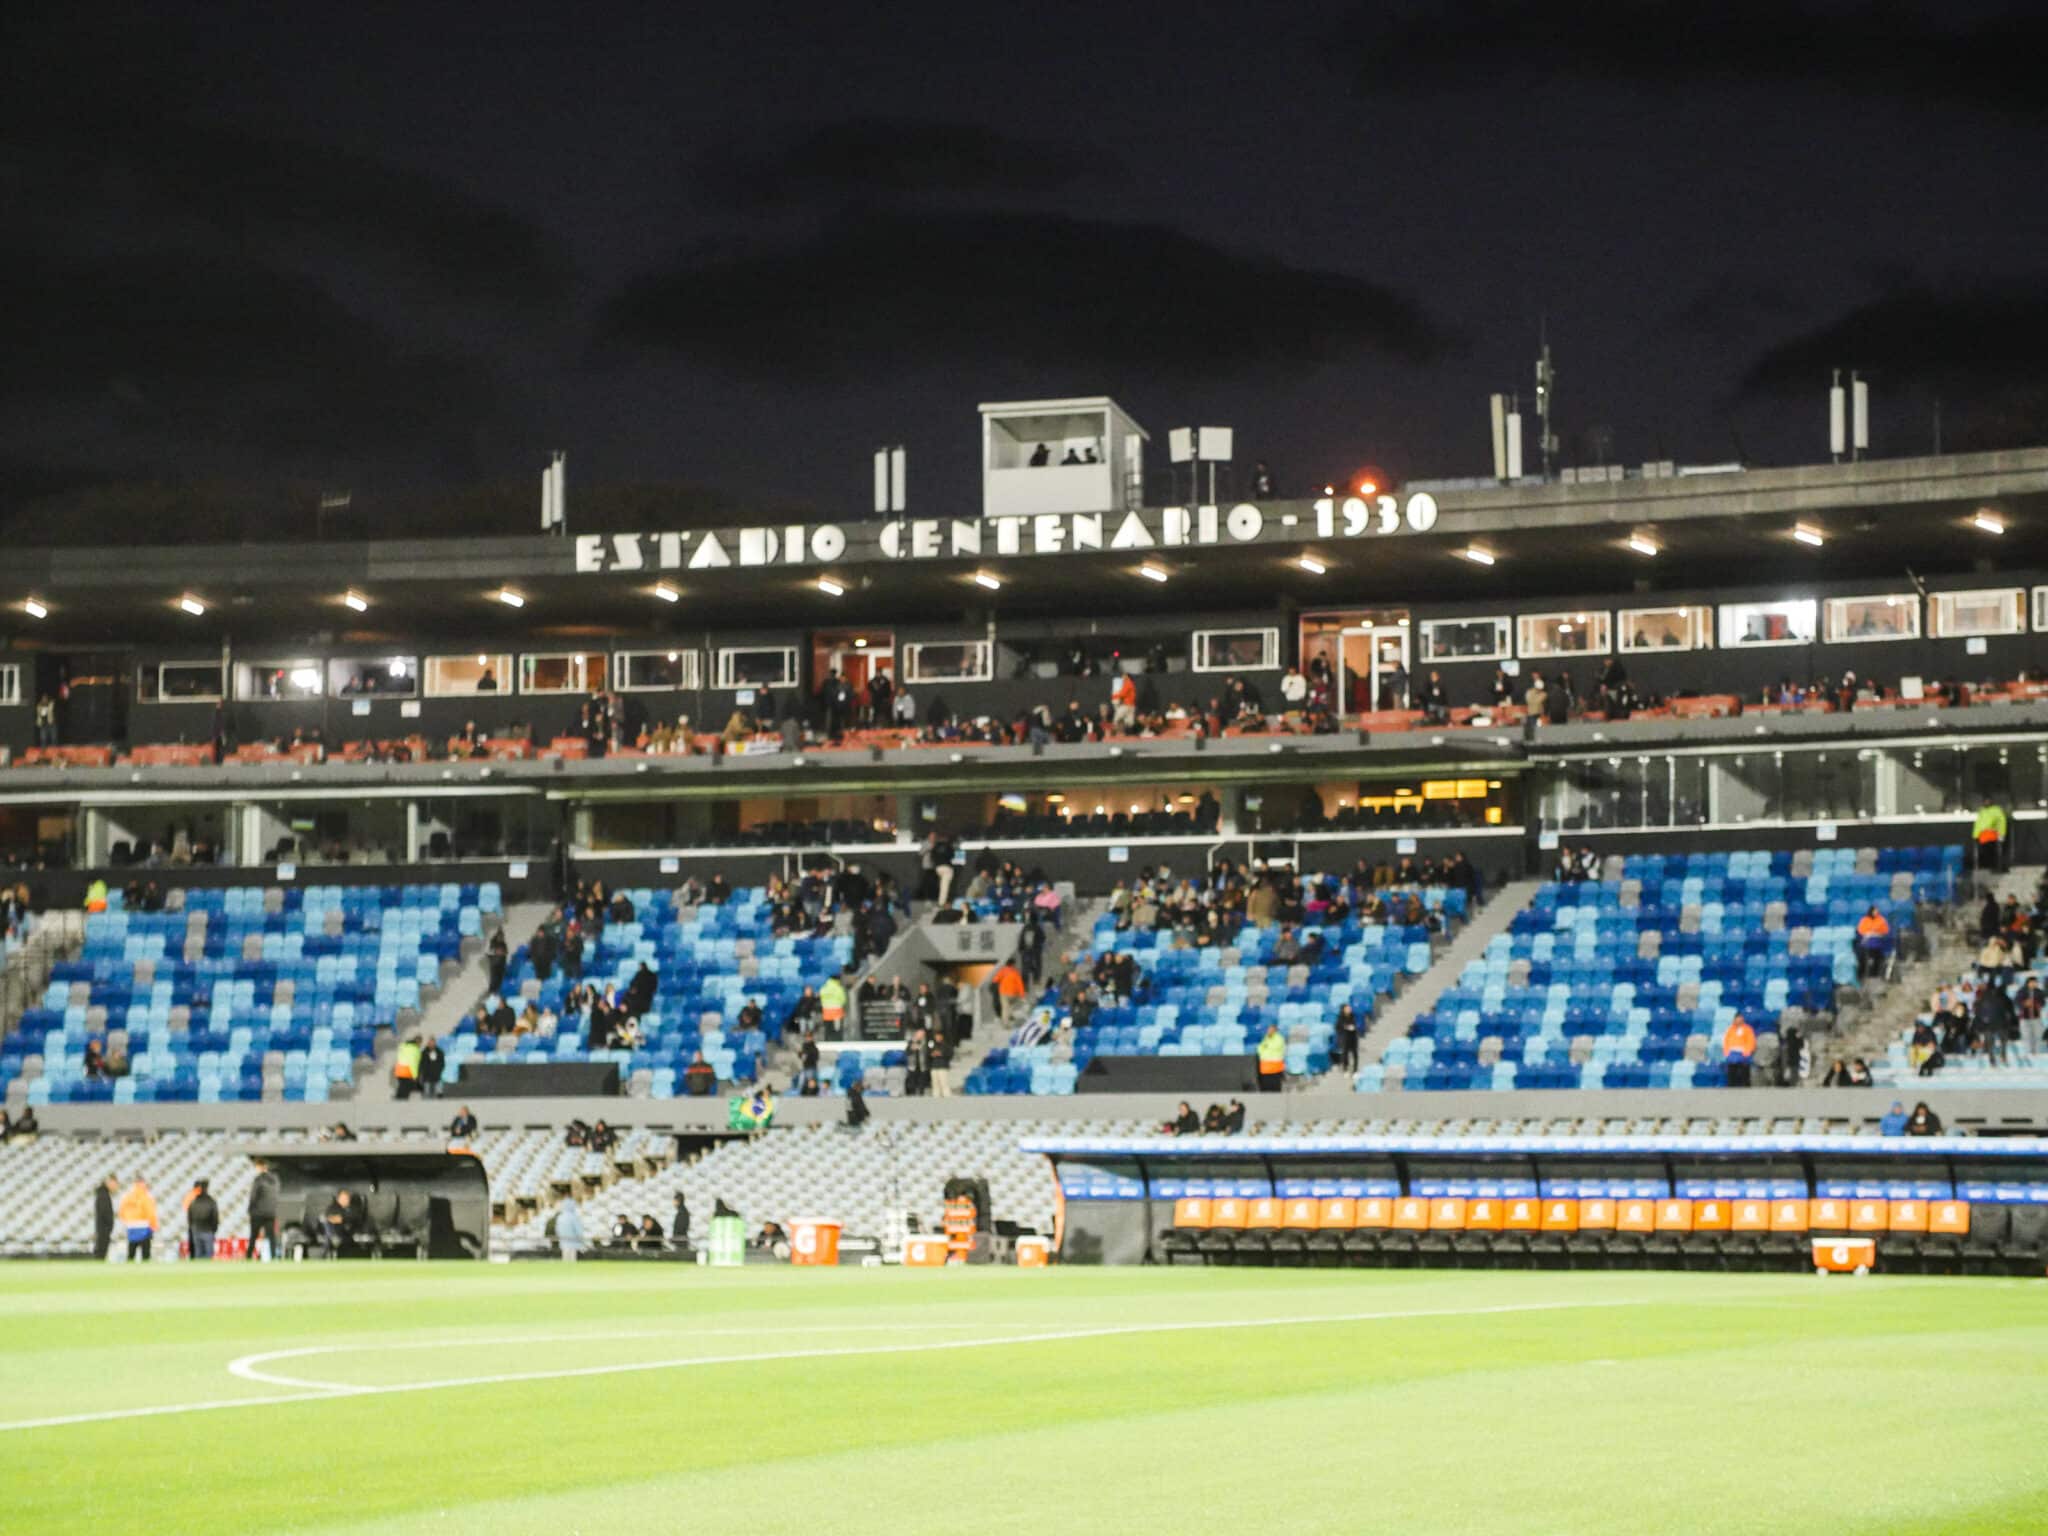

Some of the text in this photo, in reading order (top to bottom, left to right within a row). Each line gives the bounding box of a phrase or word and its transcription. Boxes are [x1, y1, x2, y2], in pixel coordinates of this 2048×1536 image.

[576, 524, 846, 572] ESTADIO
[879, 502, 1263, 559] CENTENARIO
[1313, 492, 1438, 538] 1930
